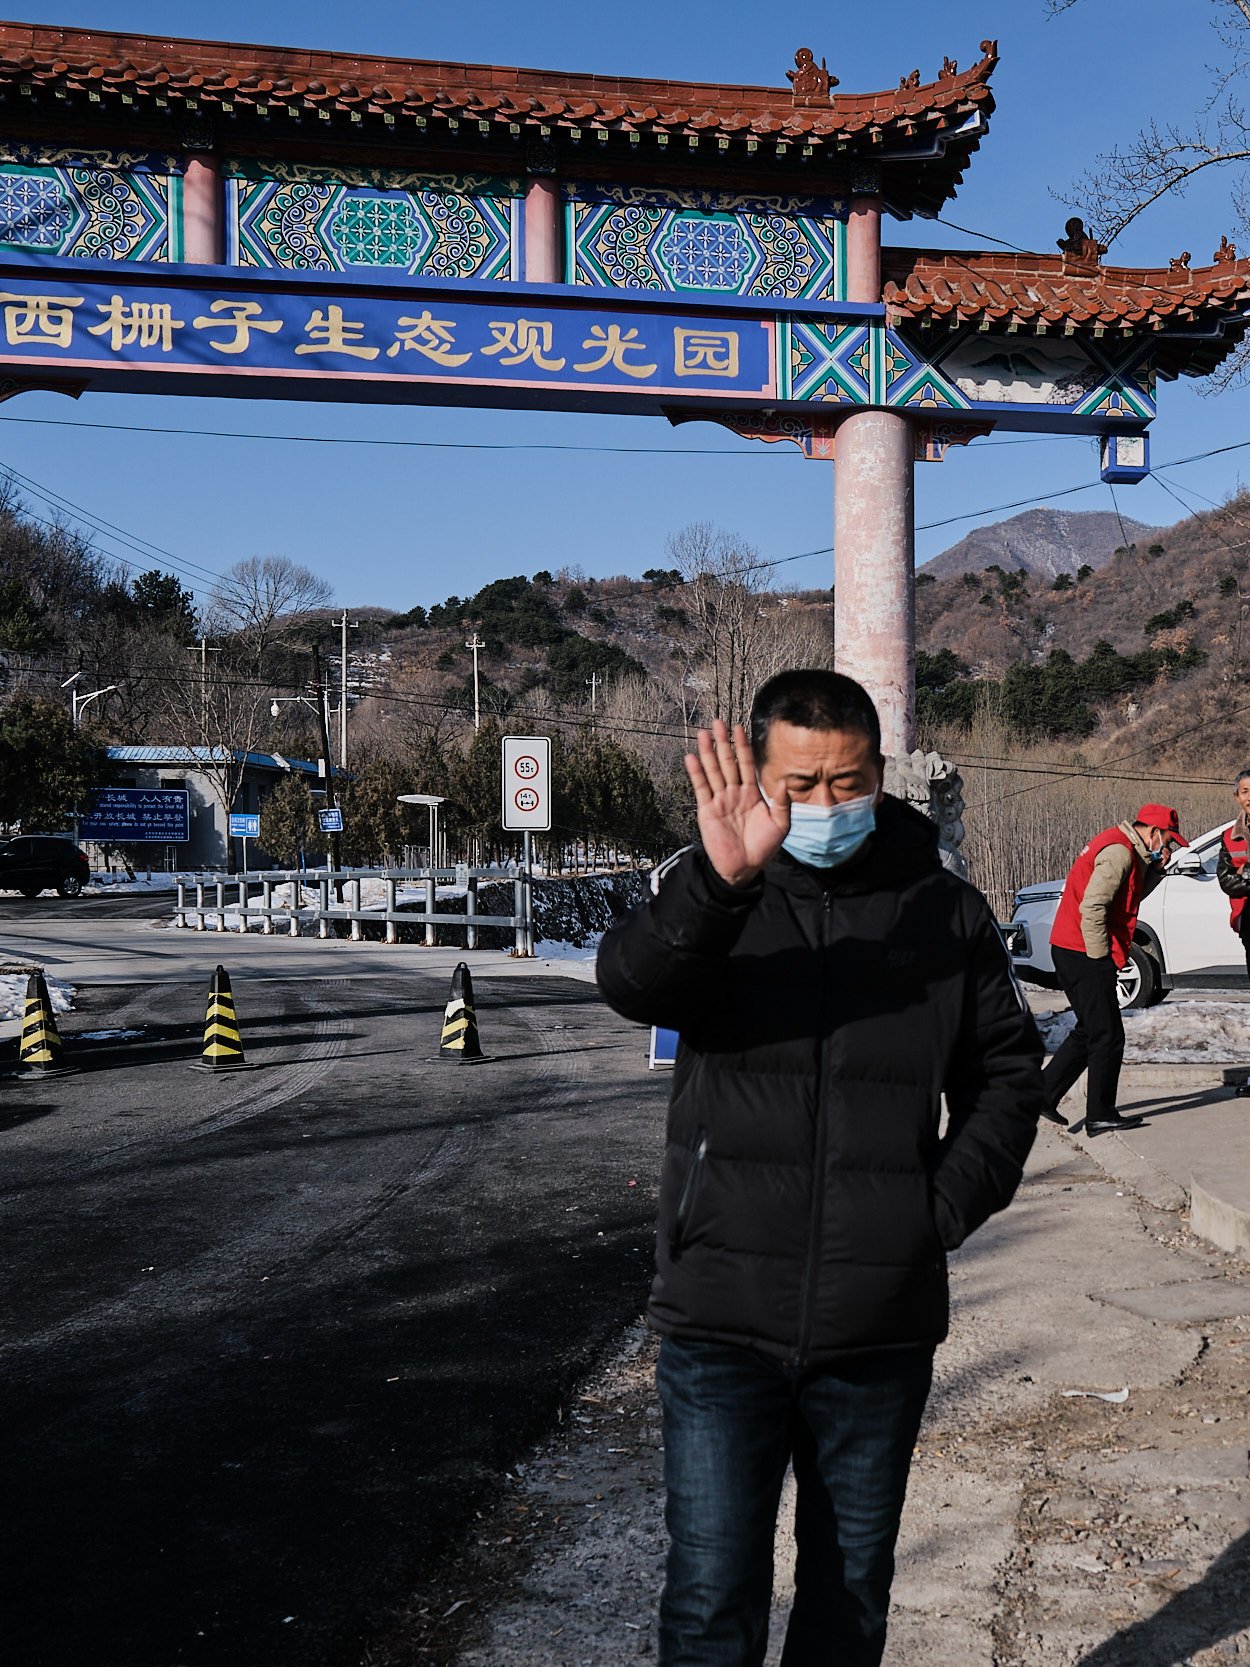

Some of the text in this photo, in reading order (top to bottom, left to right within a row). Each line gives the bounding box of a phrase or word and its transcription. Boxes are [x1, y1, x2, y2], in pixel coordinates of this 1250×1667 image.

[0, 292, 739, 377] 西栅子生态观光园
[140, 794, 184, 804] 人人有责
[89, 812, 137, 821] 开放长城
